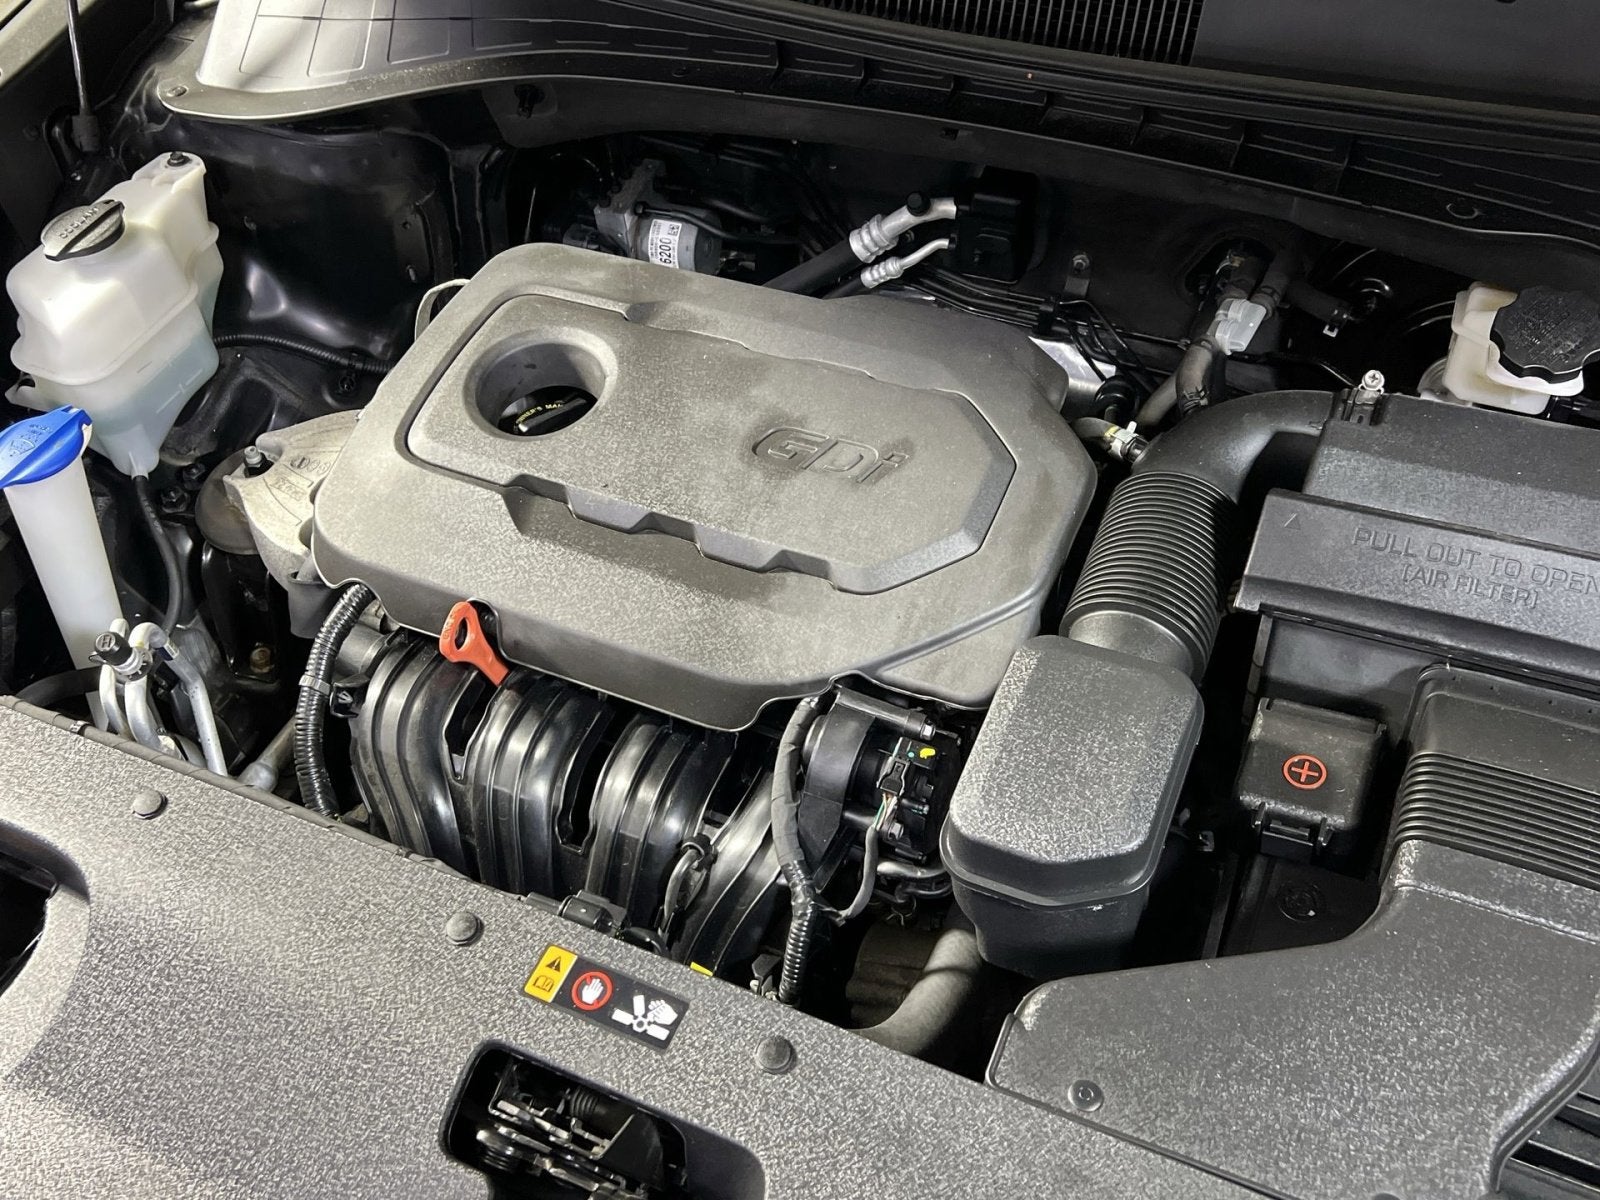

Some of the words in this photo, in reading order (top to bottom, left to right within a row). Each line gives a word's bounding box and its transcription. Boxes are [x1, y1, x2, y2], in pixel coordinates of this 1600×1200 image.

[659, 237, 672, 264] 6200
[751, 426, 910, 484] GDi
[1352, 526, 1418, 559] PULL
[1425, 542, 1481, 570] OUT
[1489, 553, 1523, 580] TO
[101, 633, 112, 649] H
